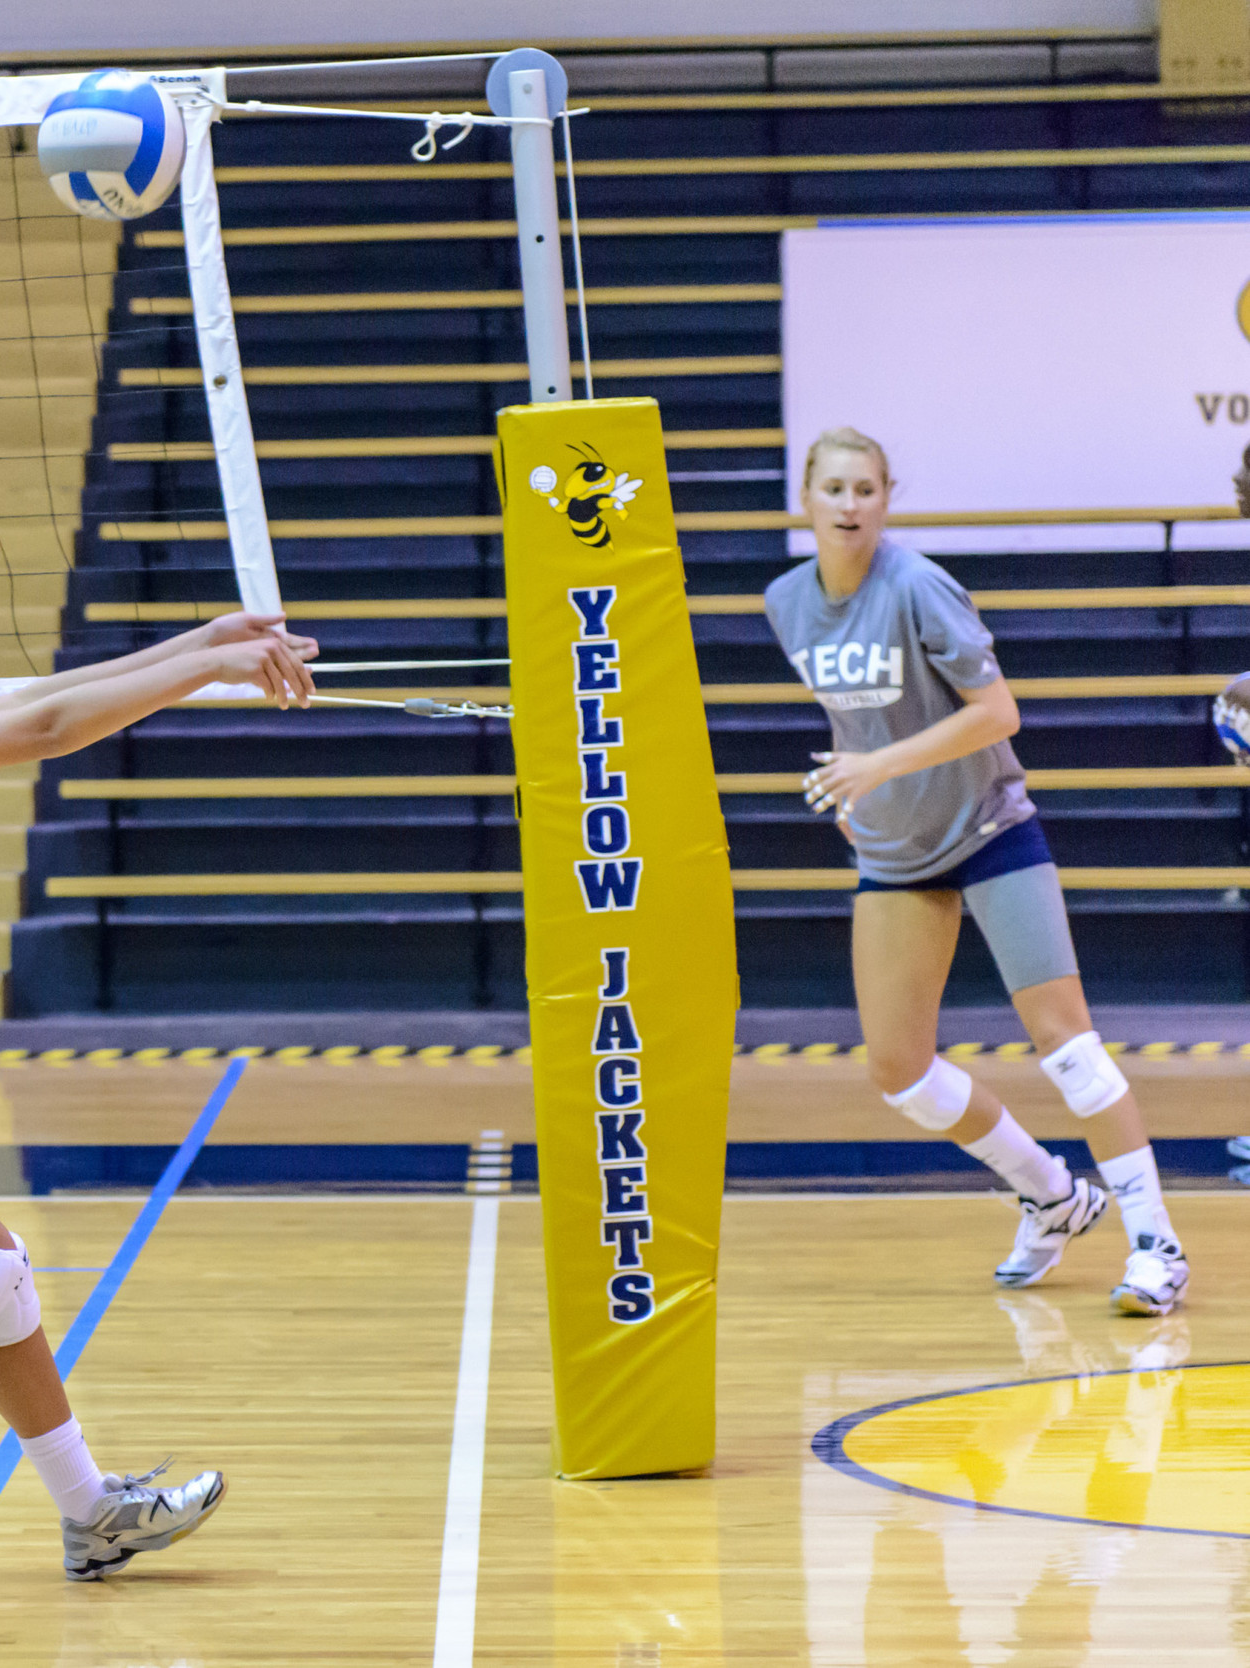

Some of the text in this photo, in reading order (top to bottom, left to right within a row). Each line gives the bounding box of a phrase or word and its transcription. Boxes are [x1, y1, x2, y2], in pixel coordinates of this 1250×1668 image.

[1193, 393, 1250, 425] VO
[791, 641, 904, 690] TECH
[568, 585, 655, 1325] YELLOW JACKETS
